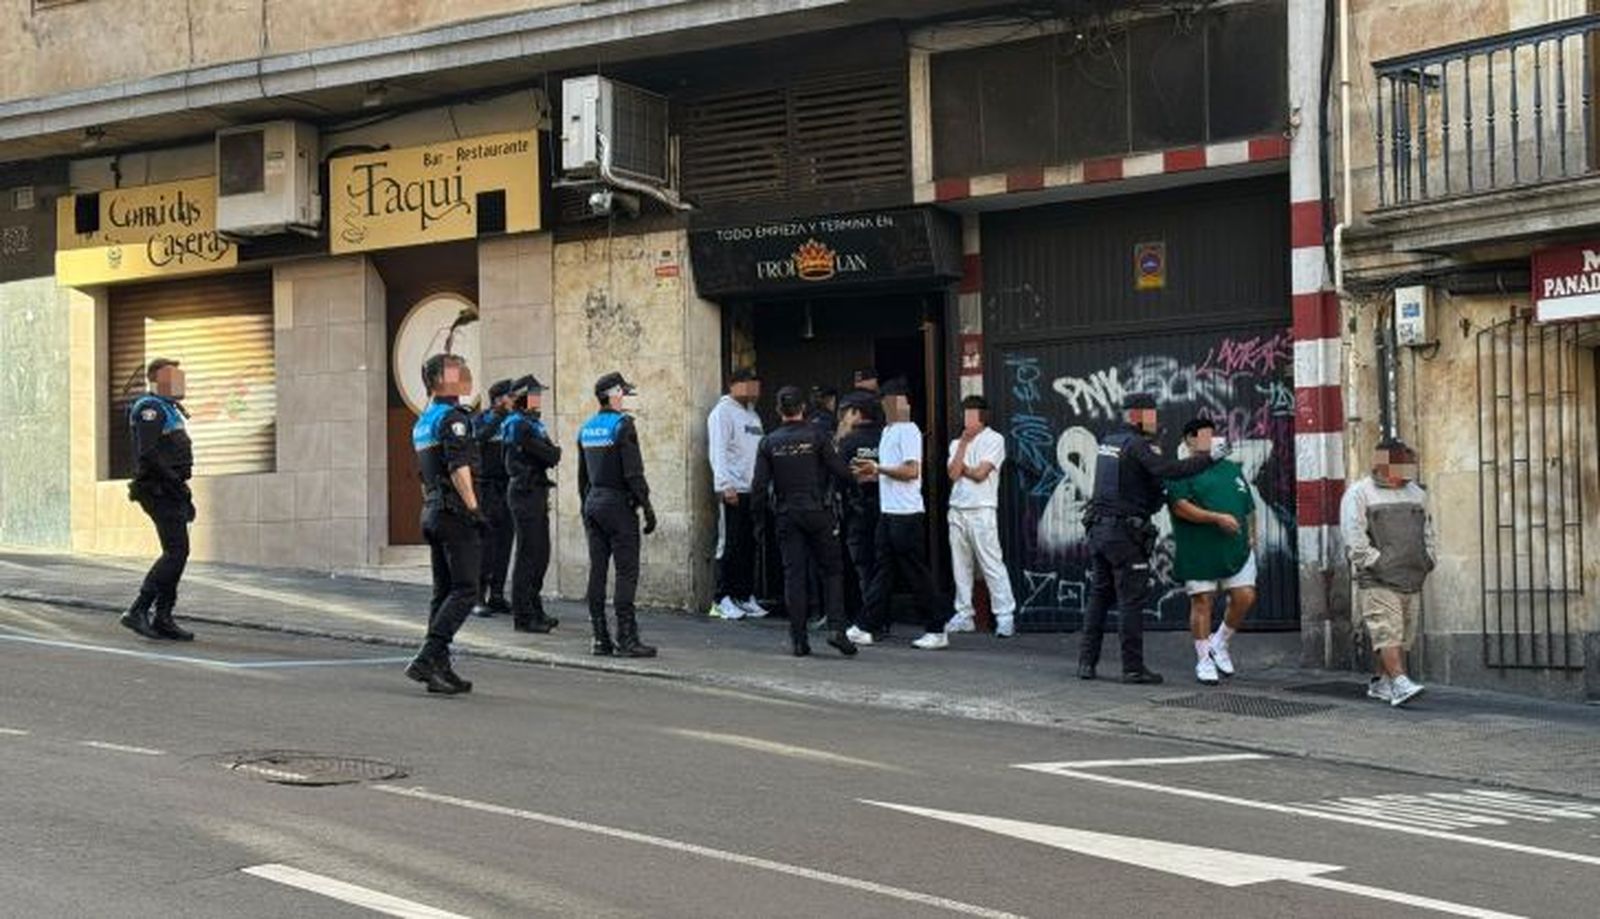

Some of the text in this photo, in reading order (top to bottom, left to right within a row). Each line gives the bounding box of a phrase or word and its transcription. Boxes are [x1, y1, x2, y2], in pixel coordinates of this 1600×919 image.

[423, 152, 444, 167] Bar
[456, 139, 529, 162] Restaurante
[346, 161, 472, 231] Taqui
[715, 215, 894, 242] TODO EMPIEZA Y TERMINA EN
[147, 229, 231, 268] Caseras
[1543, 272, 1600, 298] PANAD
